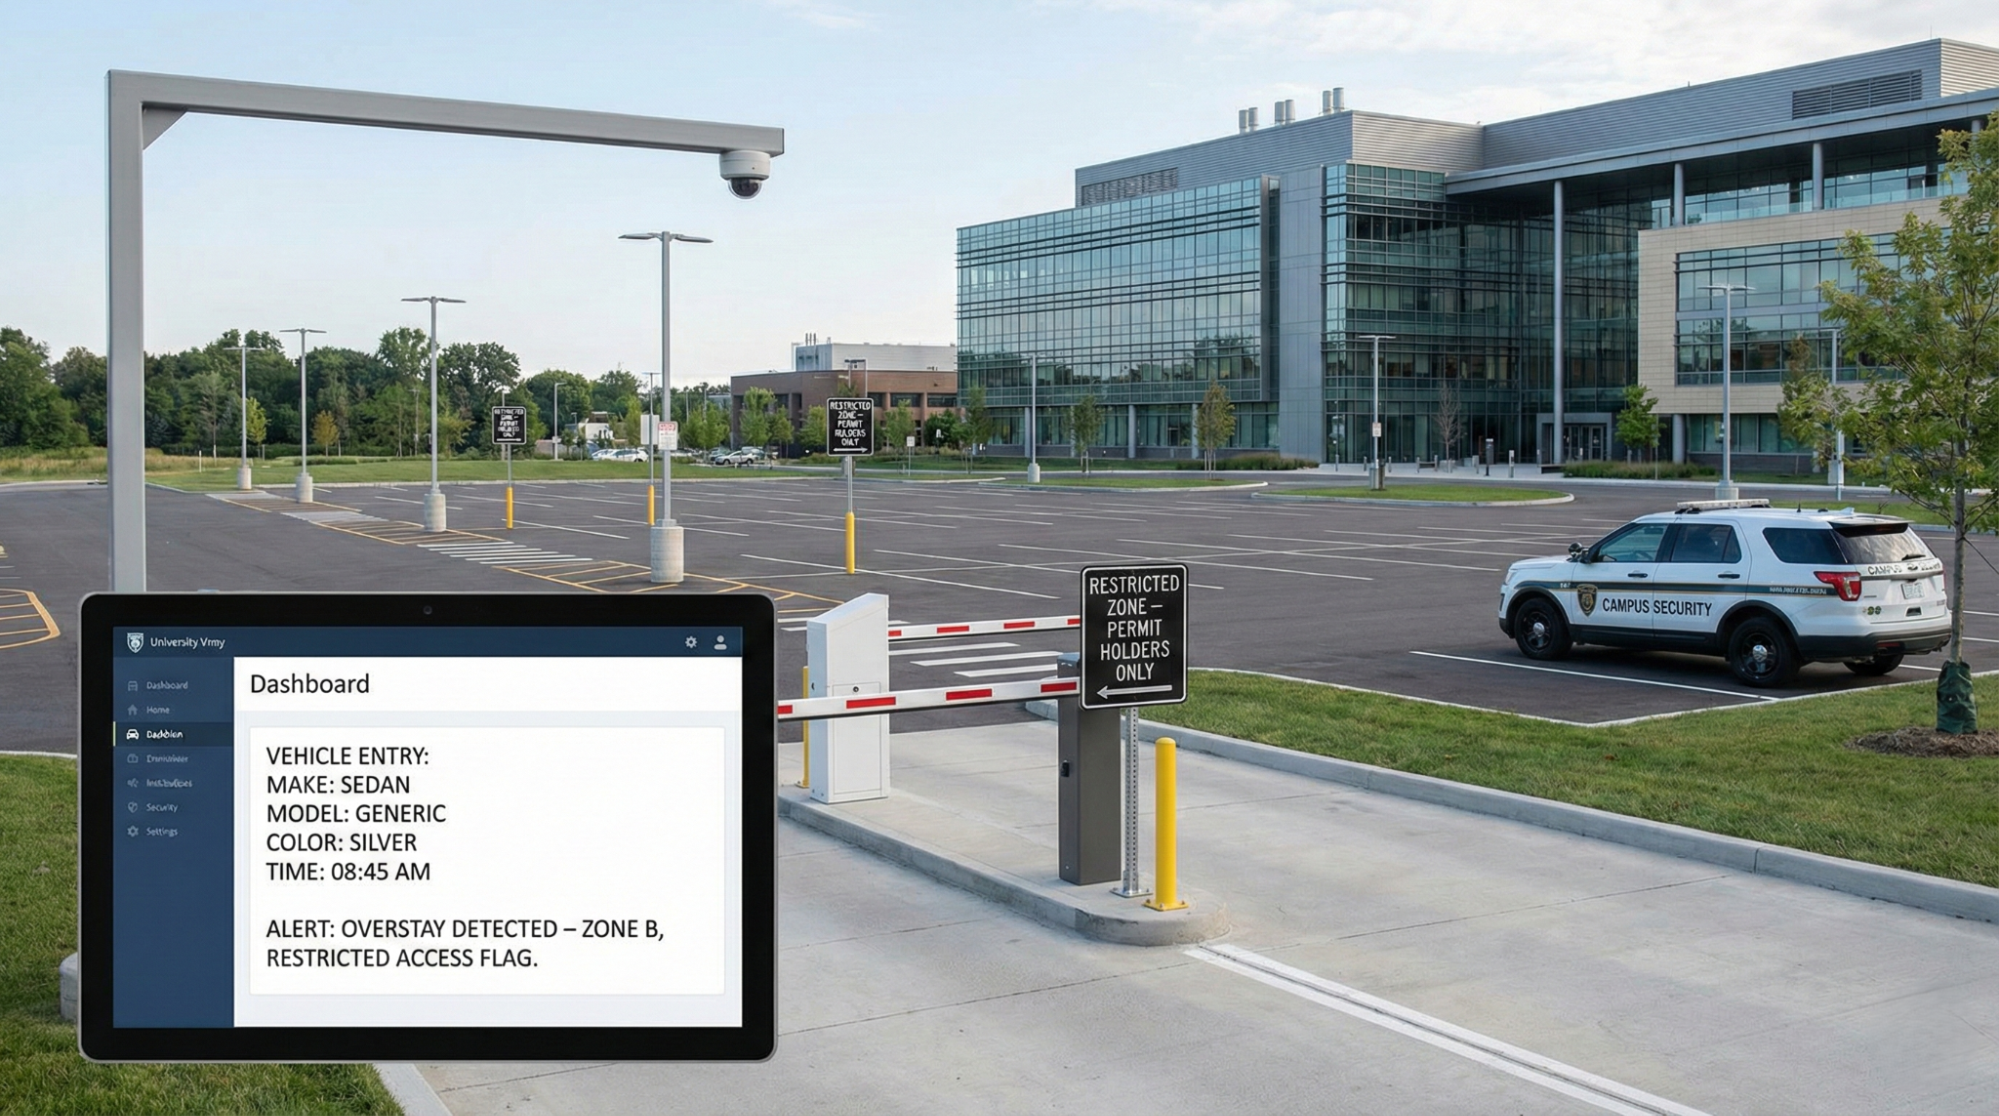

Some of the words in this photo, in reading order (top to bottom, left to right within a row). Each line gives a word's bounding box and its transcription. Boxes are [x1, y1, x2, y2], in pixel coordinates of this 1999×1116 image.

[1089, 574, 1180, 595] RESTRICTED
[1107, 598, 1147, 616] ZONE
[1602, 598, 1650, 613] CAMPUS
[1653, 600, 1713, 616] SECURITY
[1107, 619, 1163, 639] PERMIT
[1100, 640, 1170, 661] HOLDERS
[1116, 662, 1155, 681] ONLY
[146, 681, 189, 690] Dashboard
[251, 672, 370, 694] Dashboard
[146, 706, 170, 714] Home
[266, 746, 352, 765] VEHICLE
[359, 746, 429, 765] ENTRY:
[267, 775, 334, 794] MAKE:
[341, 775, 410, 794] SEDAN
[146, 803, 178, 813] Security
[267, 804, 349, 823] MODEL:
[355, 804, 447, 823] GENERIC
[146, 827, 178, 838] Settings
[266, 832, 343, 852] COLOR:
[349, 832, 417, 852] SILVER
[266, 862, 325, 881] TIME:
[331, 862, 389, 881] 08:45
[395, 862, 430, 881] AM
[266, 919, 335, 938] ALERT:
[341, 919, 445, 938] OVERSTAY
[452, 919, 557, 938] DETECTED
[581, 919, 639, 938] ZONE
[645, 919, 664, 942] B,
[267, 949, 390, 967] RESTRICTED
[396, 949, 474, 967] ACCESS
[480, 949, 538, 967] FLAG.
